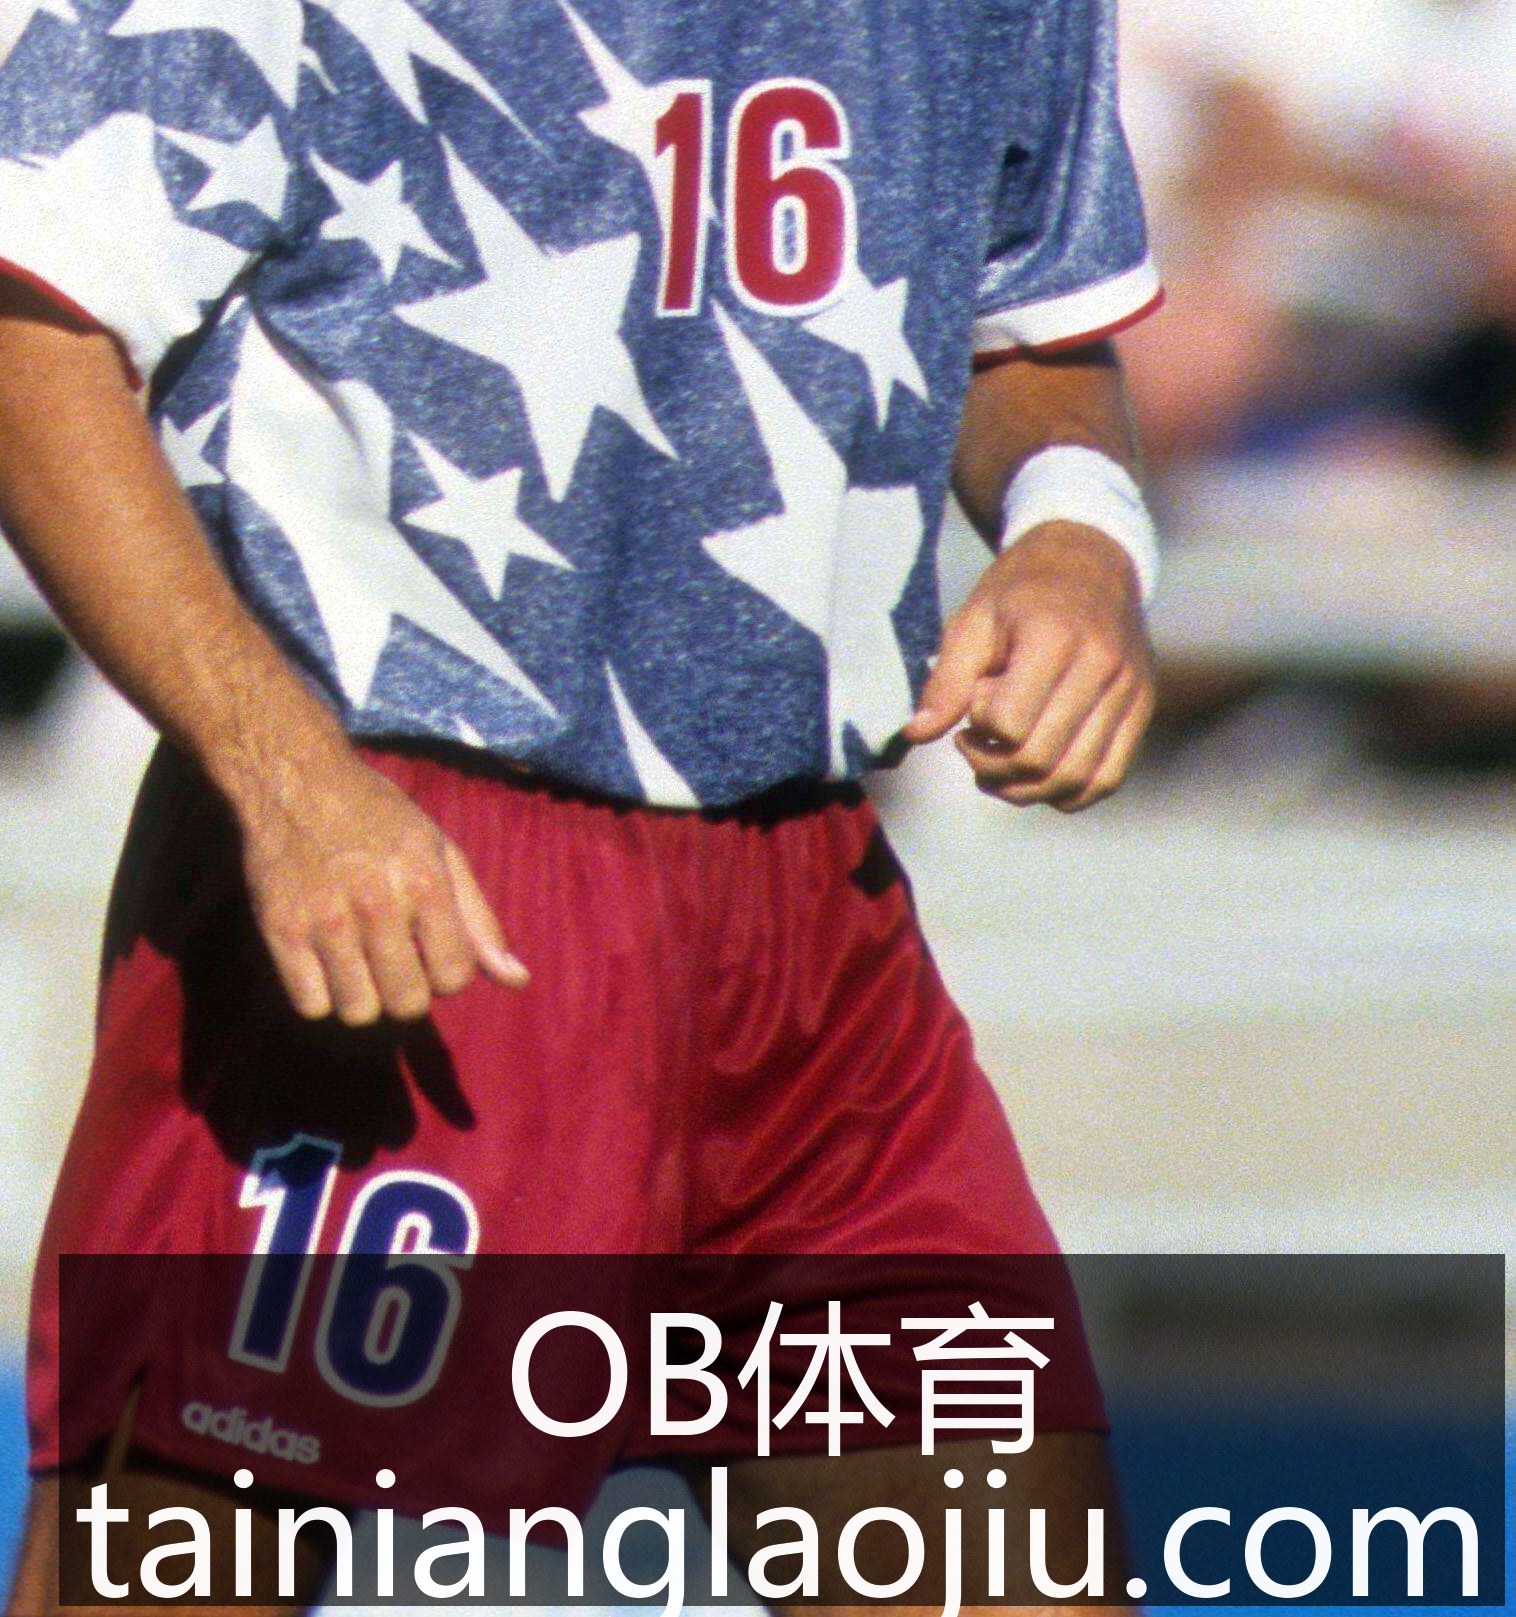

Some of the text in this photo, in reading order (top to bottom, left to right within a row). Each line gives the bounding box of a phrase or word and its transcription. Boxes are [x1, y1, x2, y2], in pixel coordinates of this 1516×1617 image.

[654, 76, 855, 320] 16
[227, 1132, 481, 1408] 16
[181, 1401, 322, 1465] adidas
